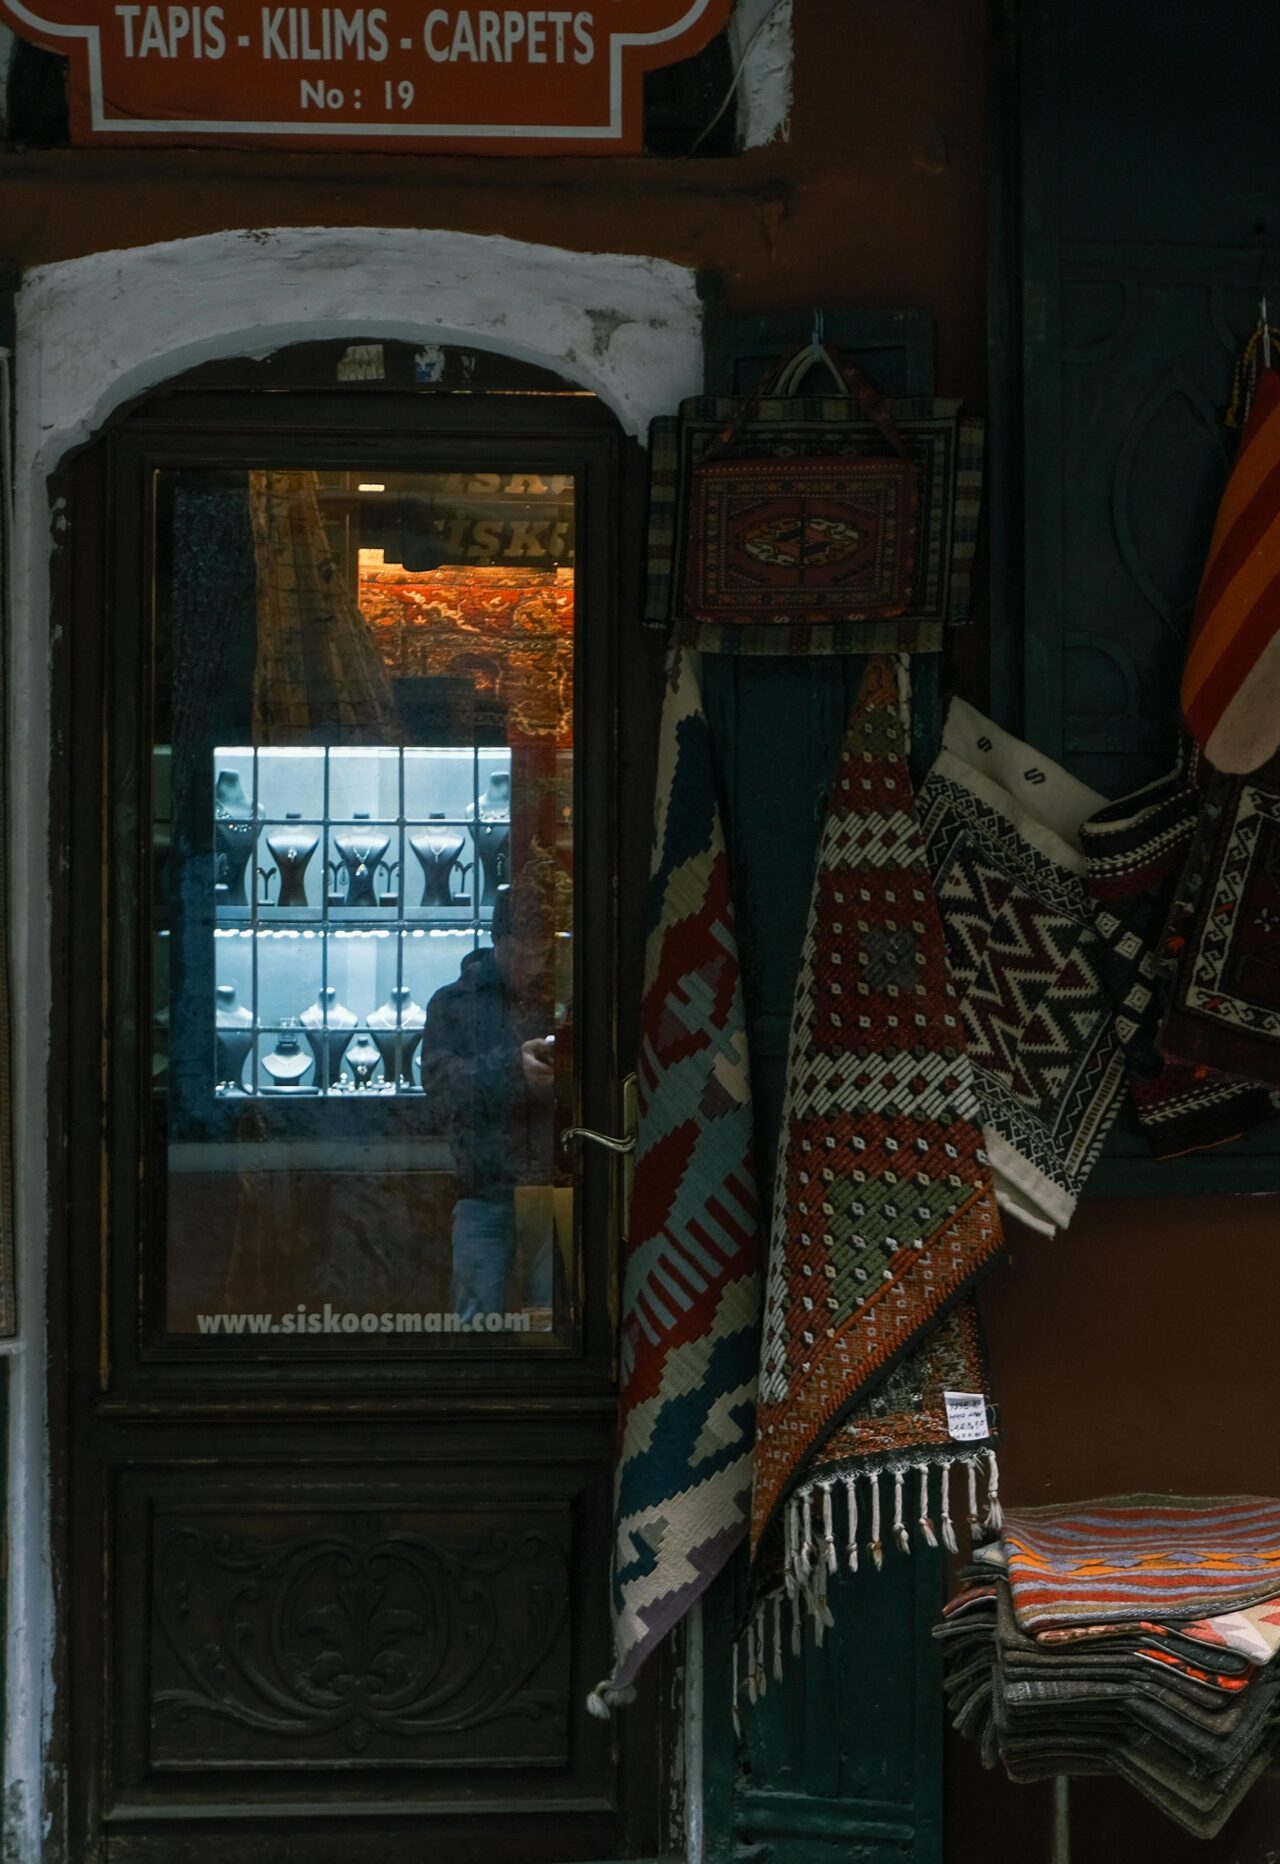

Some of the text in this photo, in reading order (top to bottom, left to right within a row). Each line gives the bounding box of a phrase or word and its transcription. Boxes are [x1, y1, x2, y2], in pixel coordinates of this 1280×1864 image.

[115, 5, 226, 59] TAPIS
[262, 7, 389, 61] KILIMS
[423, 10, 595, 64] CARPETS
[384, 80, 415, 109] 19
[197, 1303, 531, 1335] www.siskoosman.com
